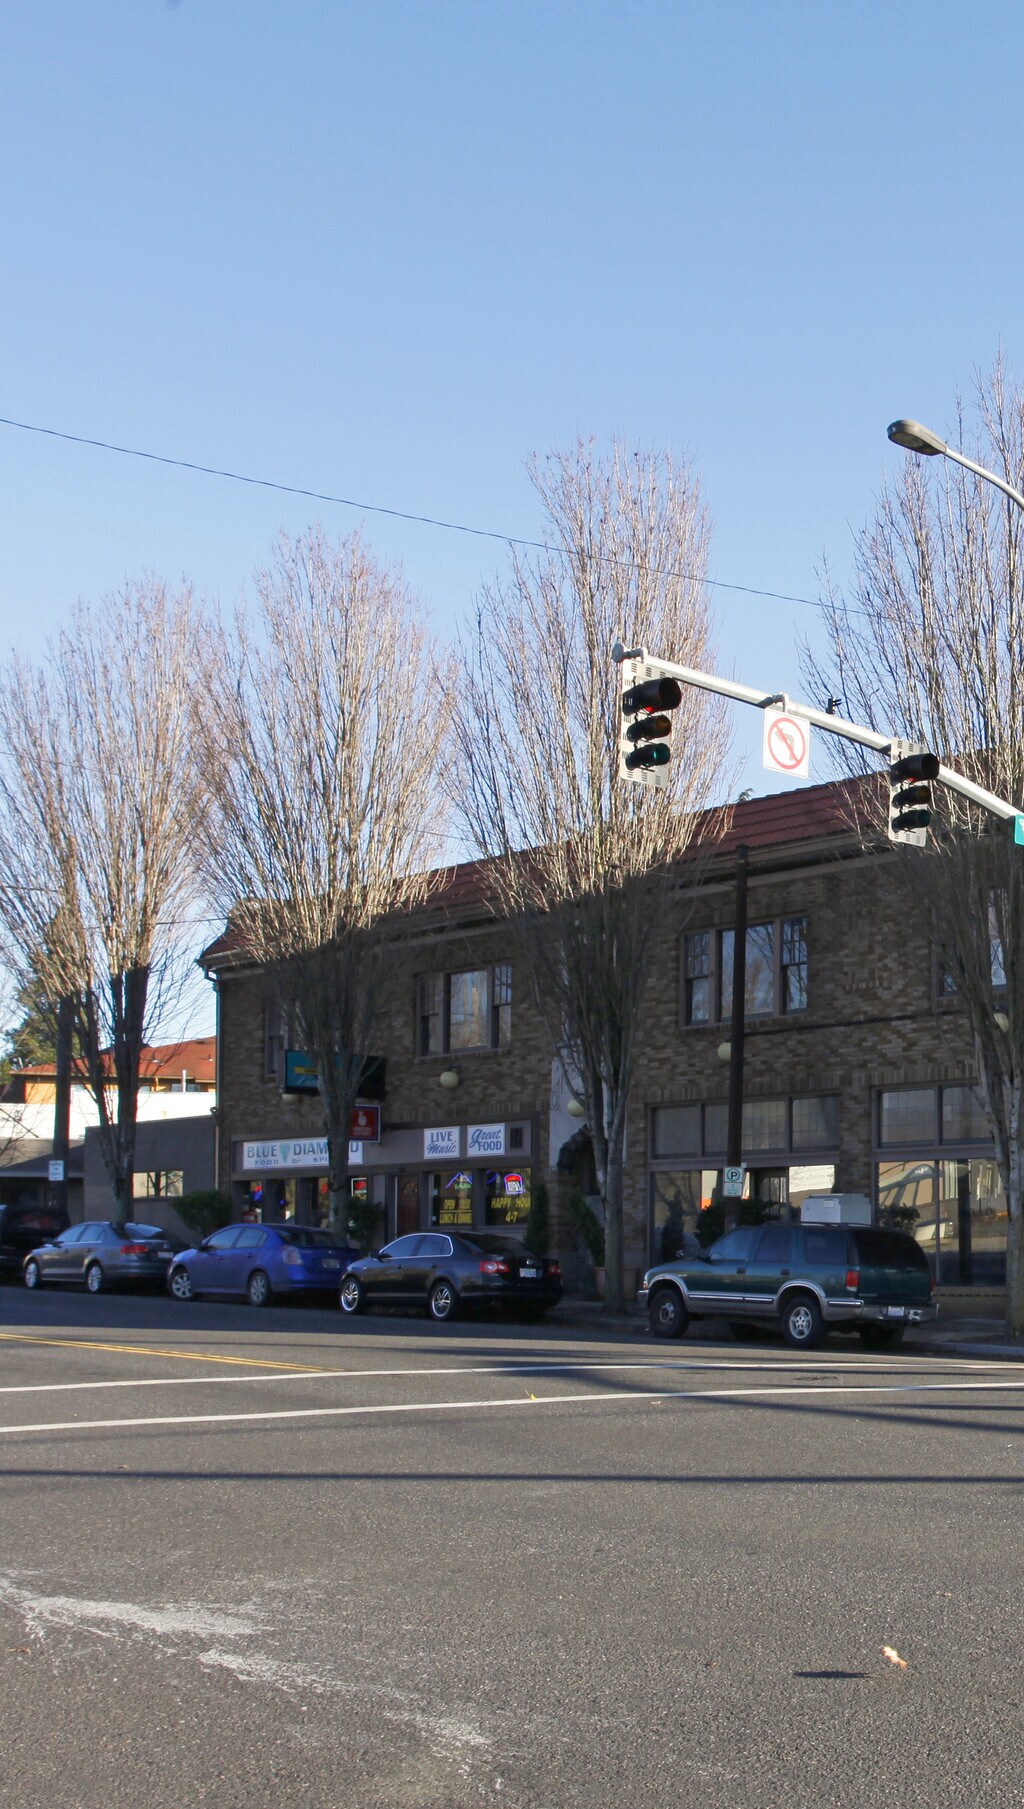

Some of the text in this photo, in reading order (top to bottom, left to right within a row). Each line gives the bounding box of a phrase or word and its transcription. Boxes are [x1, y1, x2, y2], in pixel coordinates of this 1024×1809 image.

[430, 1130, 453, 1143] LIVE
[246, 1140, 360, 1159] BLUE DIAMD
[426, 1142, 457, 1155] Music
[477, 1140, 503, 1152] FOOD
[491, 1196, 511, 1209] HAPPY
